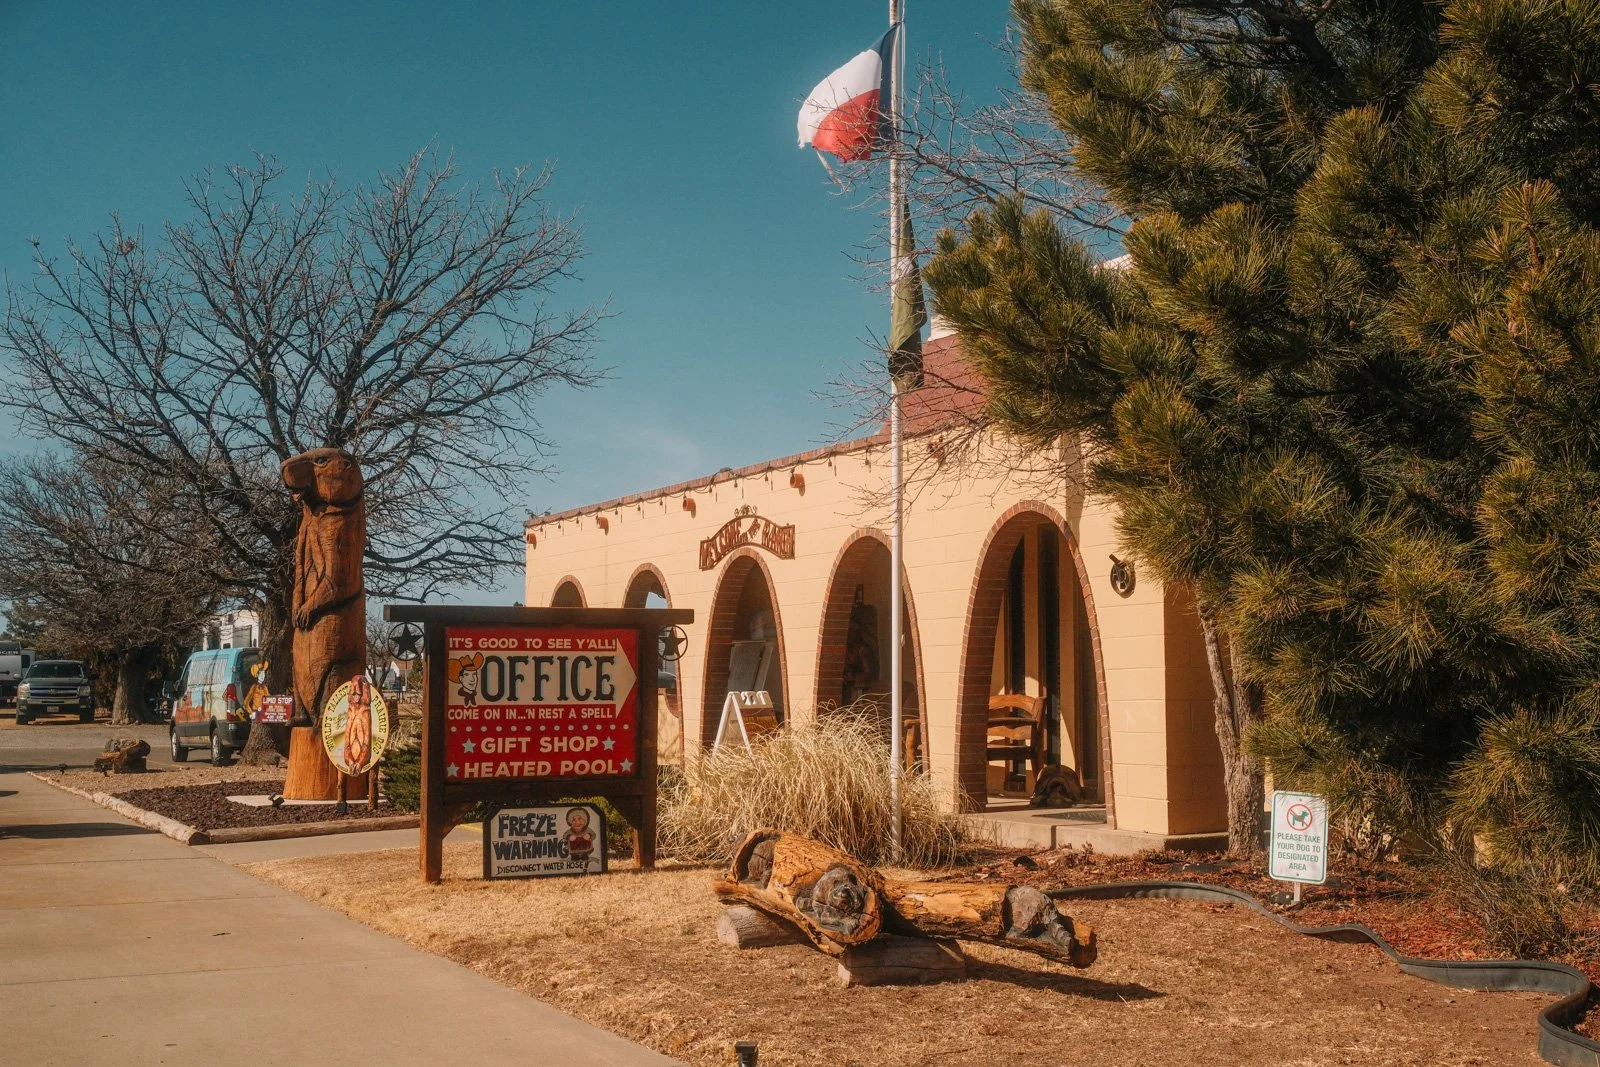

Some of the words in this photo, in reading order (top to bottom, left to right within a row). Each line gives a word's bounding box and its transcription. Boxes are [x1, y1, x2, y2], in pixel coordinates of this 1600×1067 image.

[449, 637, 473, 649] IT'S
[478, 638, 518, 649] GOOD
[525, 638, 543, 649] TO
[547, 638, 572, 649] SEE
[576, 638, 616, 650] Y'ALL!
[481, 655, 615, 702] OFFICE
[372, 695, 387, 733] PRAIRIE
[448, 708, 479, 720] COME
[484, 708, 501, 720] ON
[539, 708, 565, 719] REST
[568, 707, 577, 719] A
[581, 708, 613, 719] SPELL
[372, 737, 385, 755] DOG
[481, 737, 531, 754] GIFT
[539, 736, 599, 753] SHOP
[464, 761, 551, 778] HEATED
[560, 759, 618, 775] POOL
[498, 813, 557, 838] FREEZE
[1277, 832, 1303, 841] PLEASE
[1304, 835, 1321, 843] TAKE
[492, 838, 569, 860] WARNING
[1276, 842, 1294, 851] YOUR
[1296, 844, 1311, 852] DOG
[1312, 845, 1321, 853] TO
[1277, 852, 1319, 863] DESIGNATED
[496, 863, 541, 875] DISCONNECT
[543, 862, 564, 871] WATER
[1288, 862, 1307, 871] AREA
